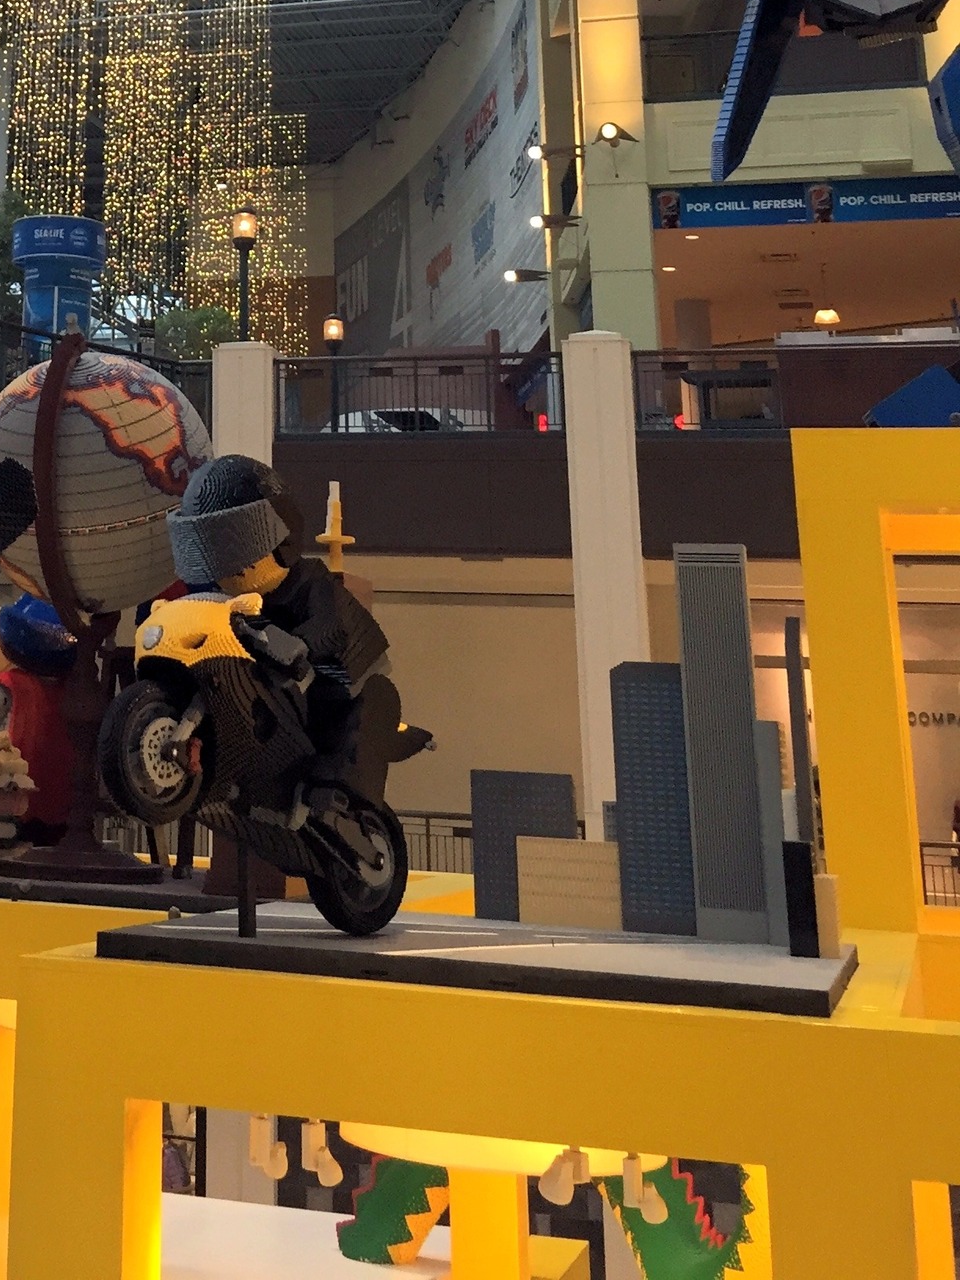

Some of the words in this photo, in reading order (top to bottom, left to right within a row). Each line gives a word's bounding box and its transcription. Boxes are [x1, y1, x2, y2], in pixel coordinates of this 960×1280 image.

[686, 203, 713, 212] POP.
[715, 201, 750, 211] CHILL.
[753, 199, 806, 209] REFRESH.
[840, 196, 868, 206] POP.
[870, 194, 907, 205] CHILL.
